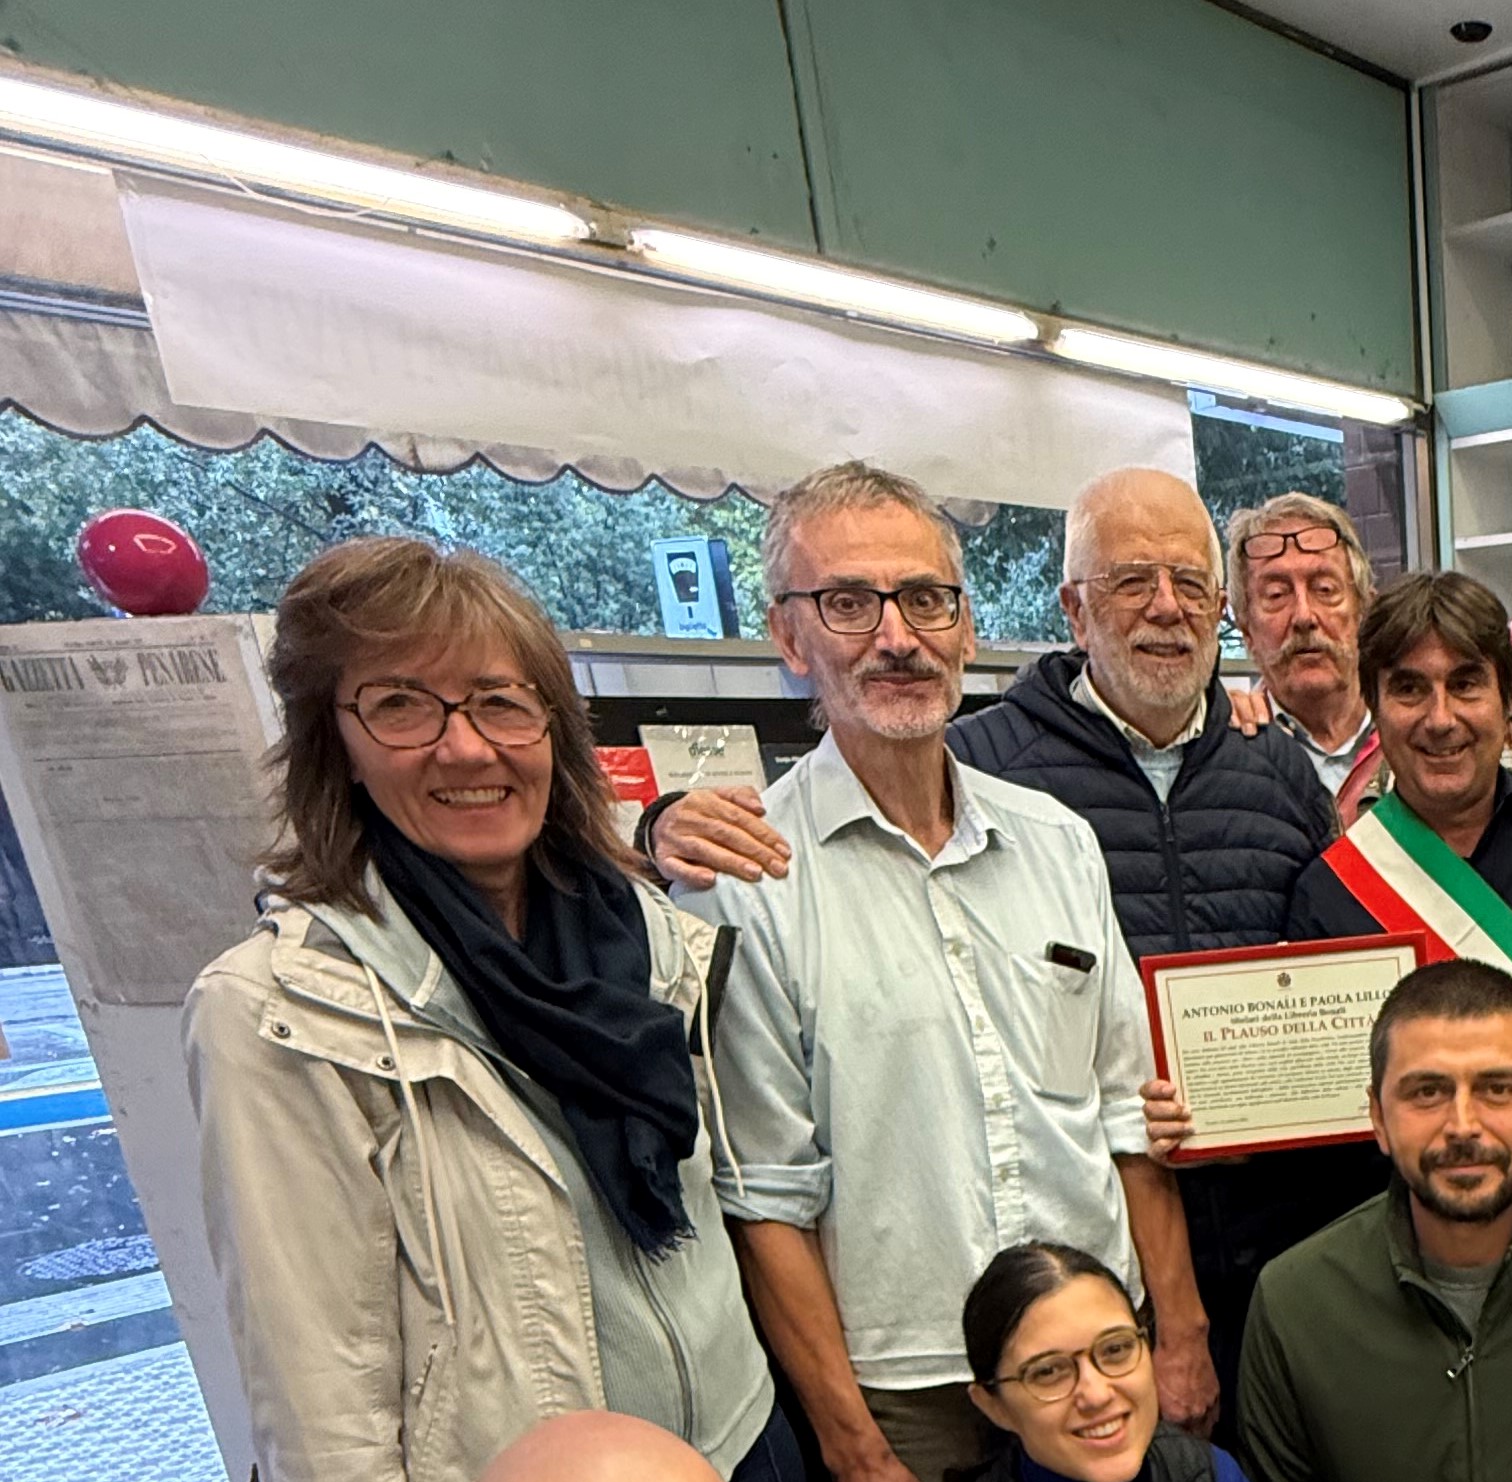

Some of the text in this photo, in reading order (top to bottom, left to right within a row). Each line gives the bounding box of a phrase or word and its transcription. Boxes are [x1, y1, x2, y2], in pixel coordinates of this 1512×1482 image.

[0, 649, 228, 692] GAZZETTA PESARESE
[1182, 1003, 1245, 1020] ANTONIO
[1301, 996, 1307, 1007] E
[1310, 994, 1351, 1006] PAOLA
